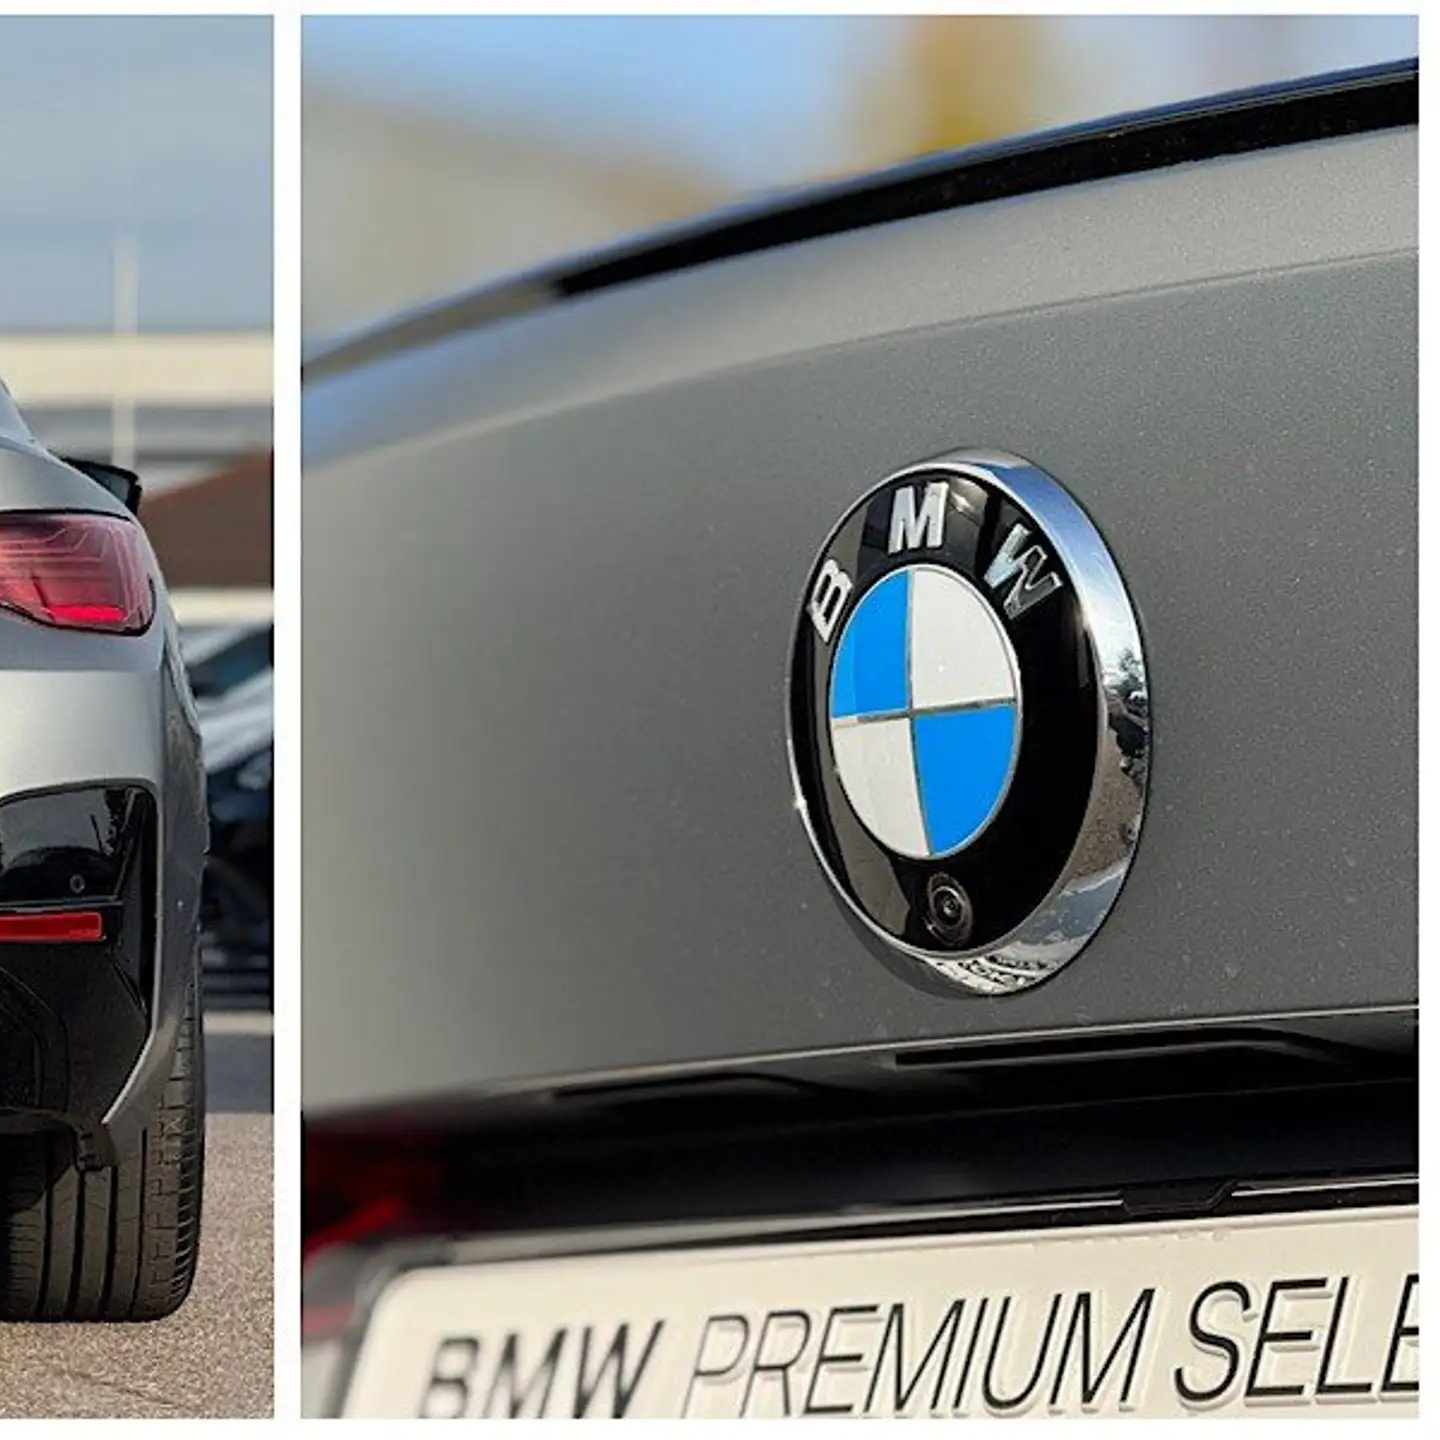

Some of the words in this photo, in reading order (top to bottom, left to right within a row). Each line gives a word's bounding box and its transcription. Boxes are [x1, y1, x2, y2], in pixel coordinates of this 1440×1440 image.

[806, 481, 1063, 643] BMW
[418, 1320, 665, 1418] BMW
[681, 1288, 1157, 1418] PREMIUM
